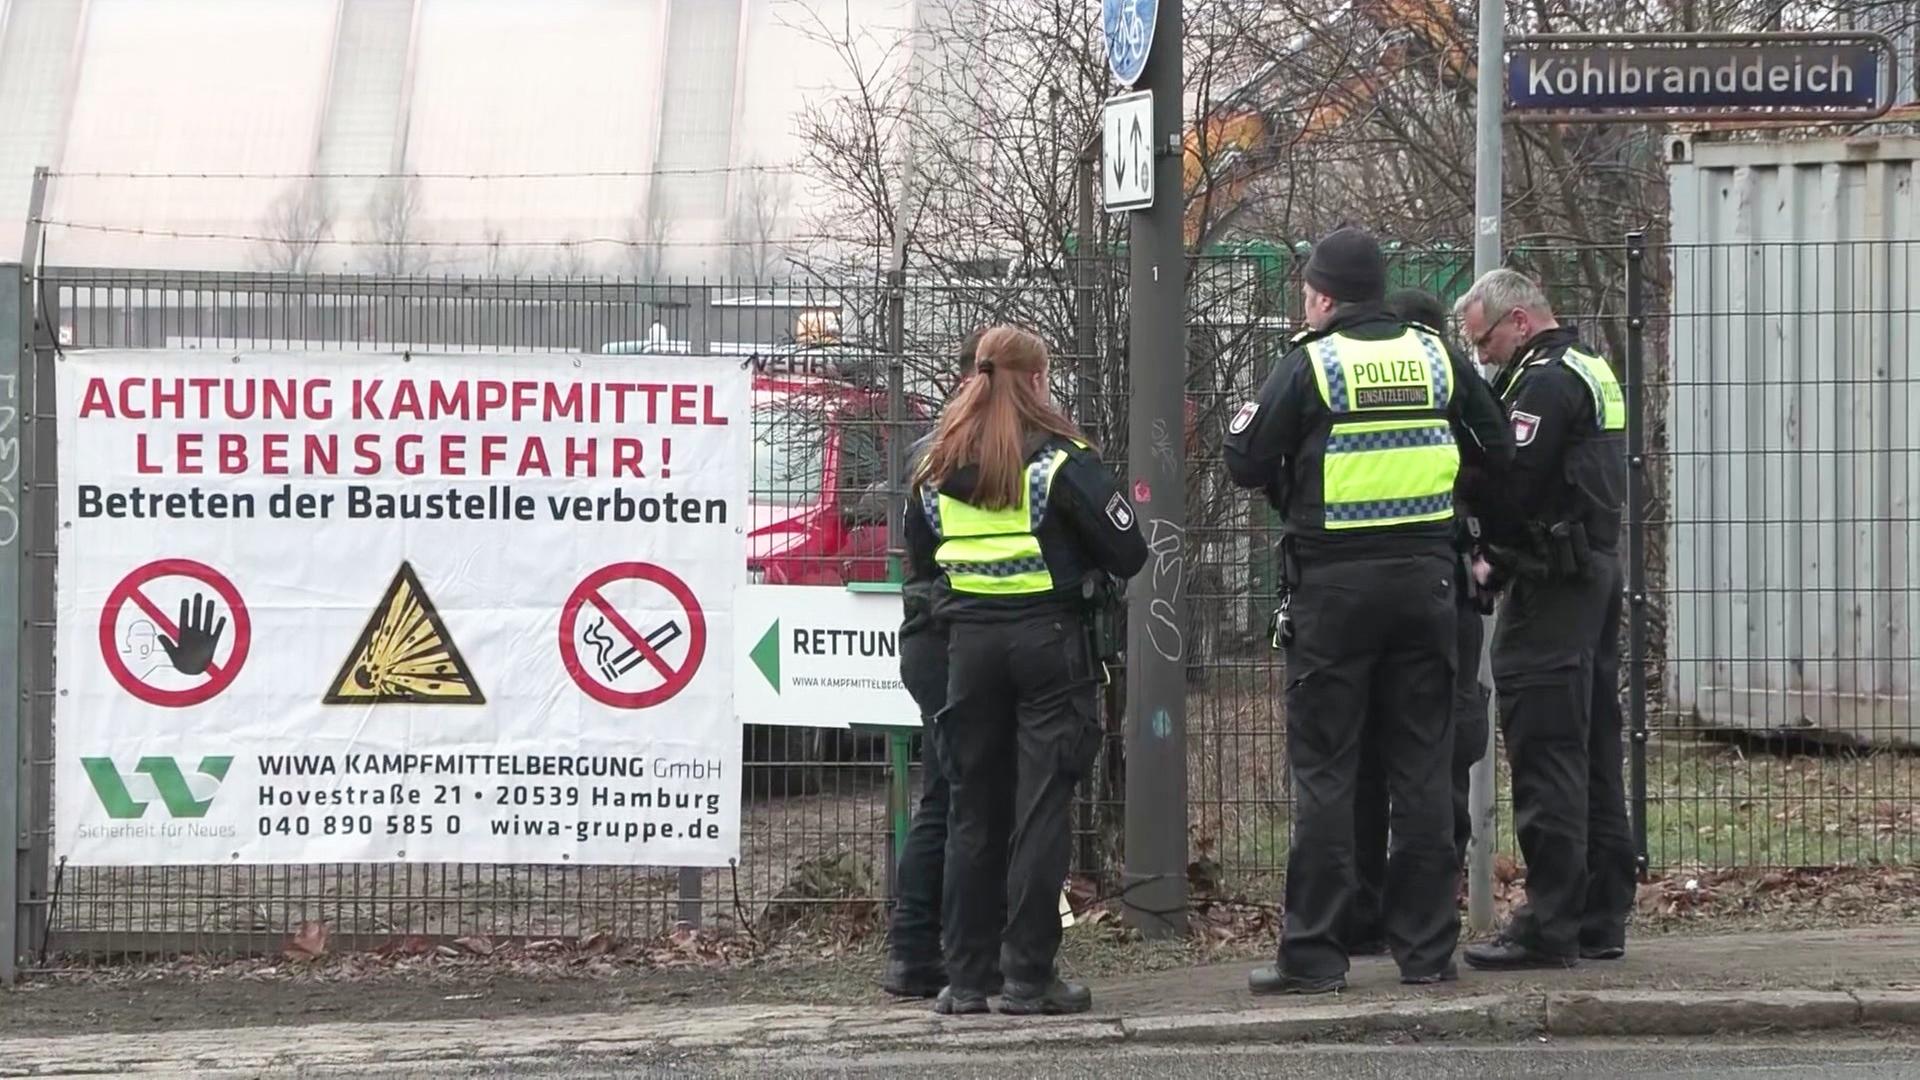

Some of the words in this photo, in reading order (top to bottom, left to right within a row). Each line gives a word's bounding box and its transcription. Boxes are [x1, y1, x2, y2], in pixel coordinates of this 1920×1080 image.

[1529, 54, 1854, 95] Köhlbranddeich
[1353, 360, 1425, 384] POLIZEI
[79, 377, 333, 421] ACHTUNG
[352, 379, 729, 425] KAMPFMITTEL
[1358, 387, 1427, 404] EINSATZLEITUNG
[137, 433, 672, 479] LEBENSGEFAHR!
[78, 484, 255, 519] Betreten
[269, 484, 335, 519] der
[348, 485, 536, 521] Baustelle
[548, 488, 727, 524] verboten
[793, 628, 900, 658] RETTUN
[791, 677, 819, 687] WIWA
[820, 677, 905, 690] KAMPFMITTELBERG
[258, 754, 336, 776] WIWA
[345, 753, 644, 778] KAMPFMITTELBERGUNG
[653, 757, 722, 780] GmbH
[258, 783, 421, 806] Hovestraße
[433, 785, 461, 805] 21
[496, 786, 579, 807] 20539
[592, 787, 720, 815] Hamburg
[78, 823, 155, 839] Sicherheit
[160, 823, 183, 839] für
[187, 823, 236, 839] Neues
[258, 815, 310, 837] 040
[323, 814, 373, 836] 890
[386, 814, 433, 836] 585
[446, 814, 461, 835] 0
[490, 813, 720, 843] wiwa-gruppe.de
